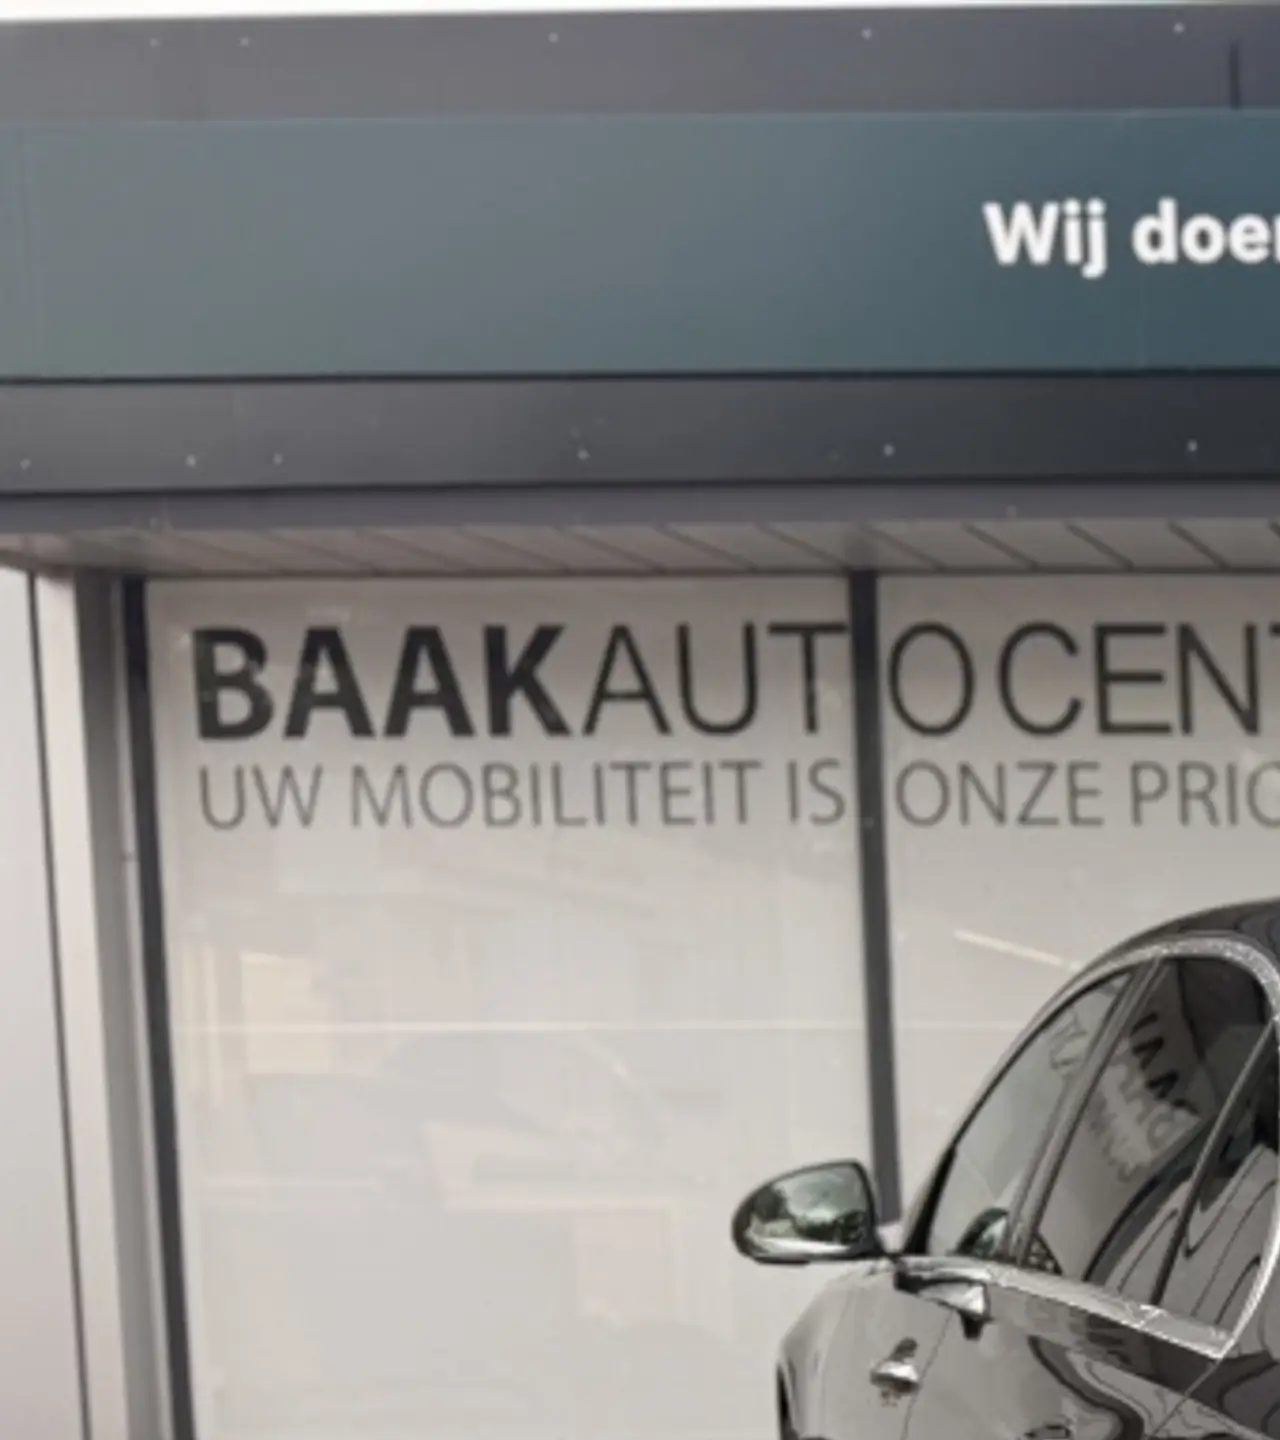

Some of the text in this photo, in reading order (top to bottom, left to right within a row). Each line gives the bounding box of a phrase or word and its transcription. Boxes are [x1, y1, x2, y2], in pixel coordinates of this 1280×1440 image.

[984, 203, 1107, 279] Wij
[199, 763, 324, 831] UW
[350, 760, 763, 829] MOBILITEIT
[786, 758, 848, 827] IS
[895, 760, 1104, 828] ONZE
